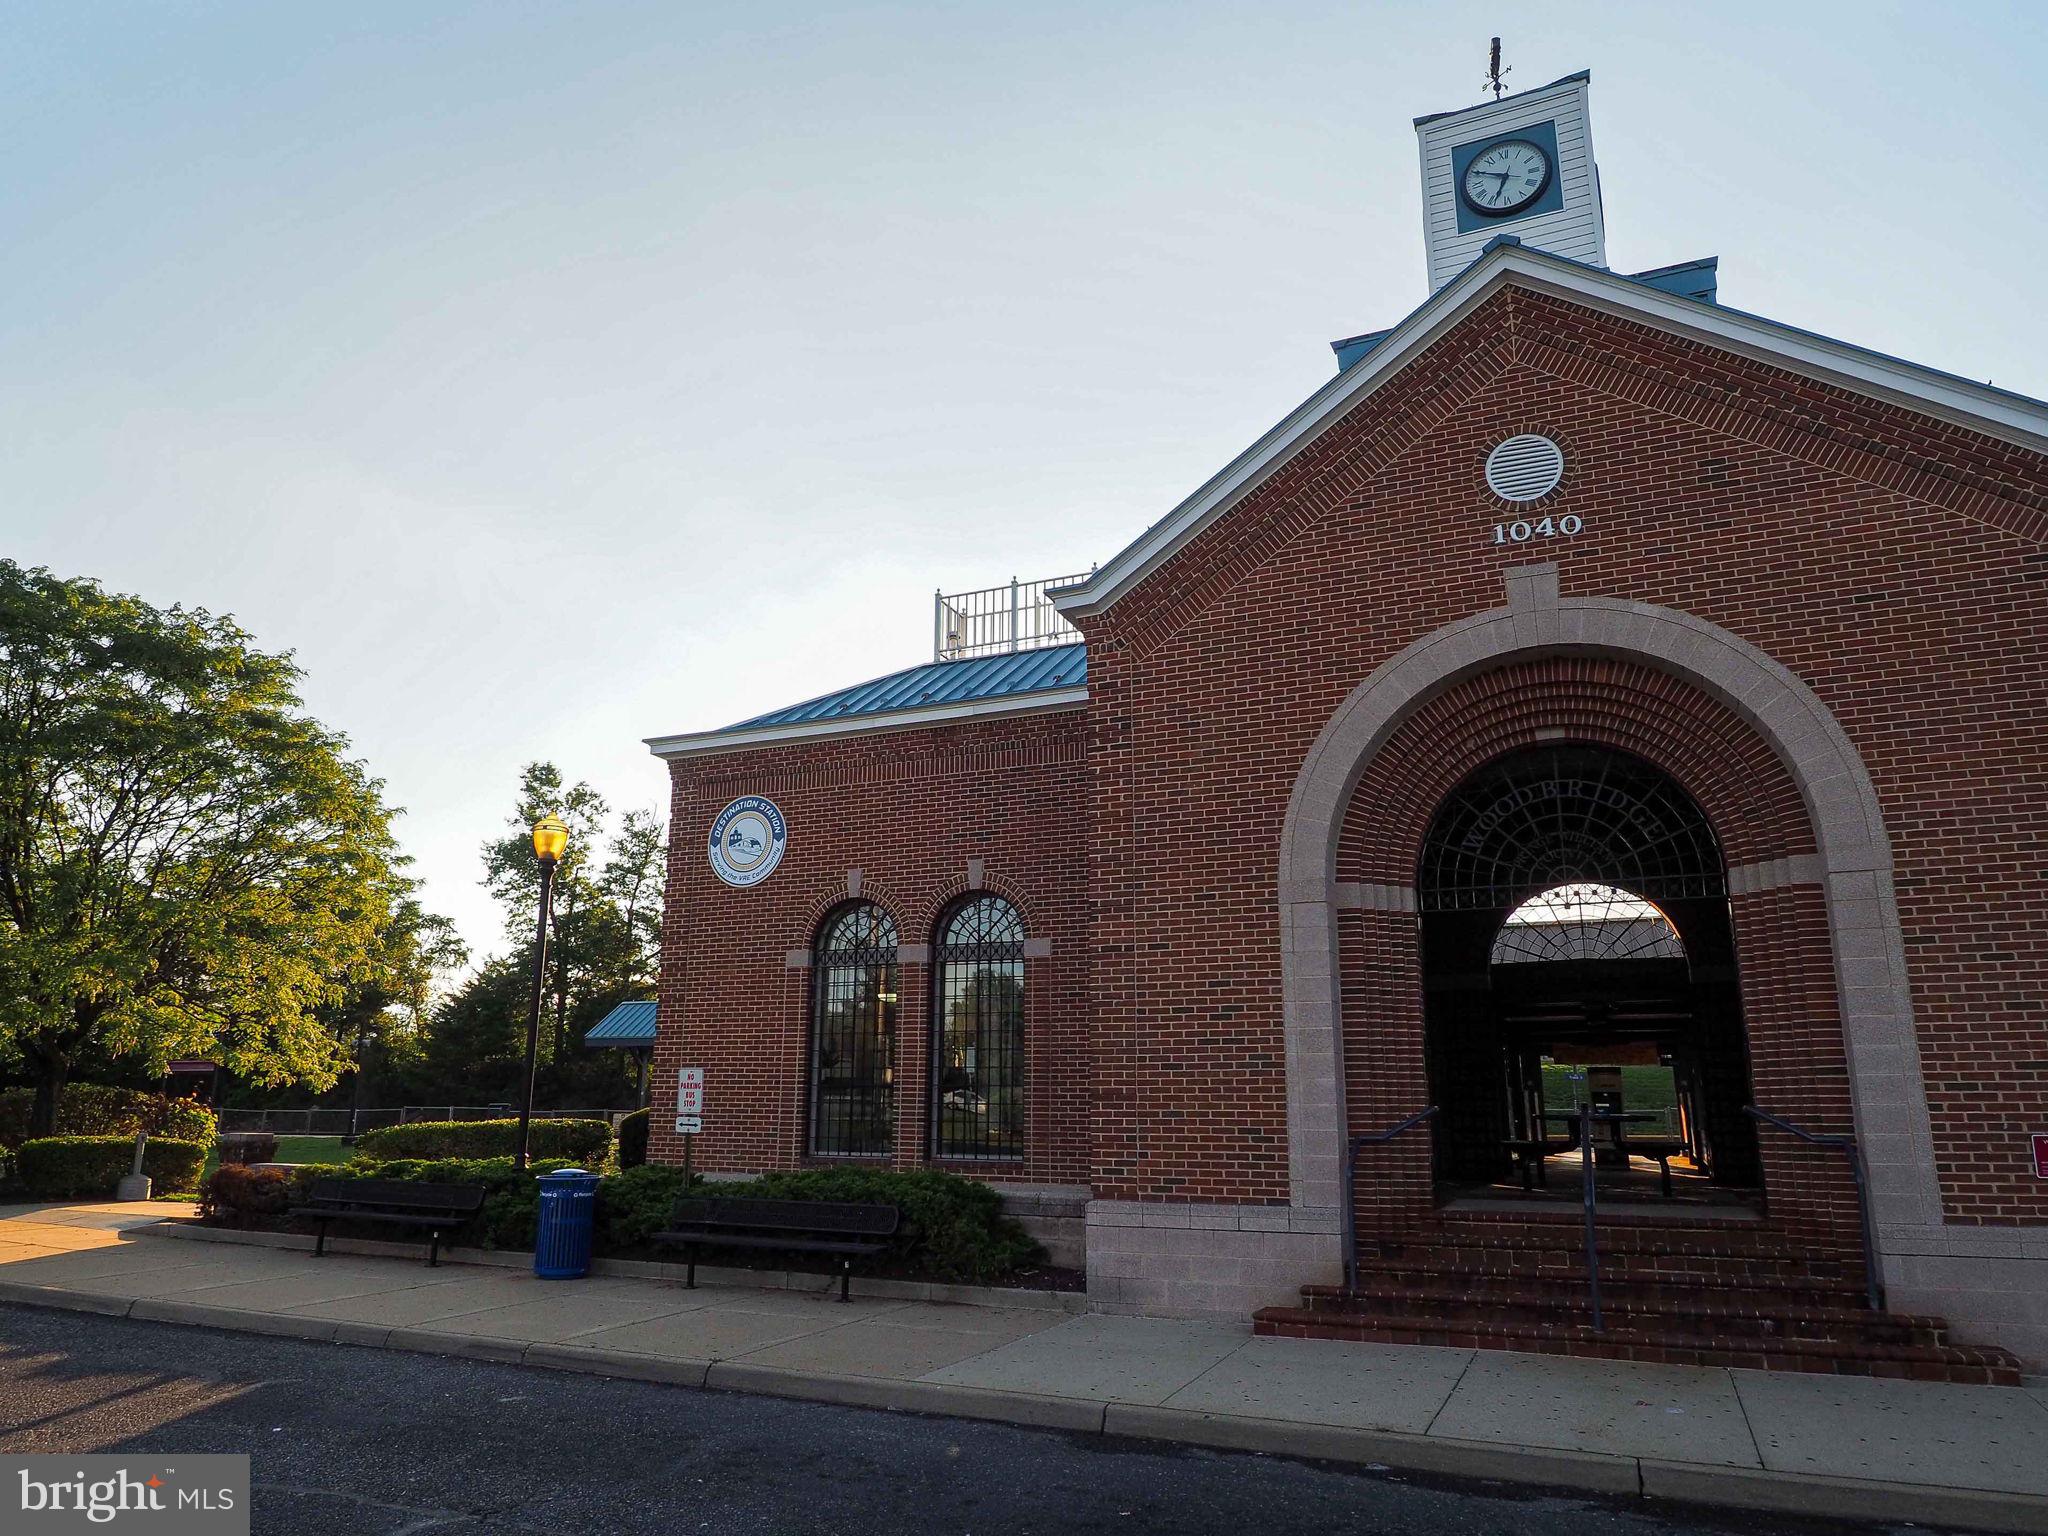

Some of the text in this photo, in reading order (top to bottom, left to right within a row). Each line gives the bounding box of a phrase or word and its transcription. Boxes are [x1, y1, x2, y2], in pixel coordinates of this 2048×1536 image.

[1493, 515, 1582, 544] 1040
[714, 799, 781, 838] DESTINATION STATION
[1461, 780, 1667, 852] WOODBRIDGE
[712, 851, 728, 876] Serving
[727, 872, 738, 881] the
[751, 846, 781, 879] Community
[680, 1082, 702, 1090] PARKING
[687, 1073, 695, 1081] NO
[685, 1091, 695, 1099] BUS
